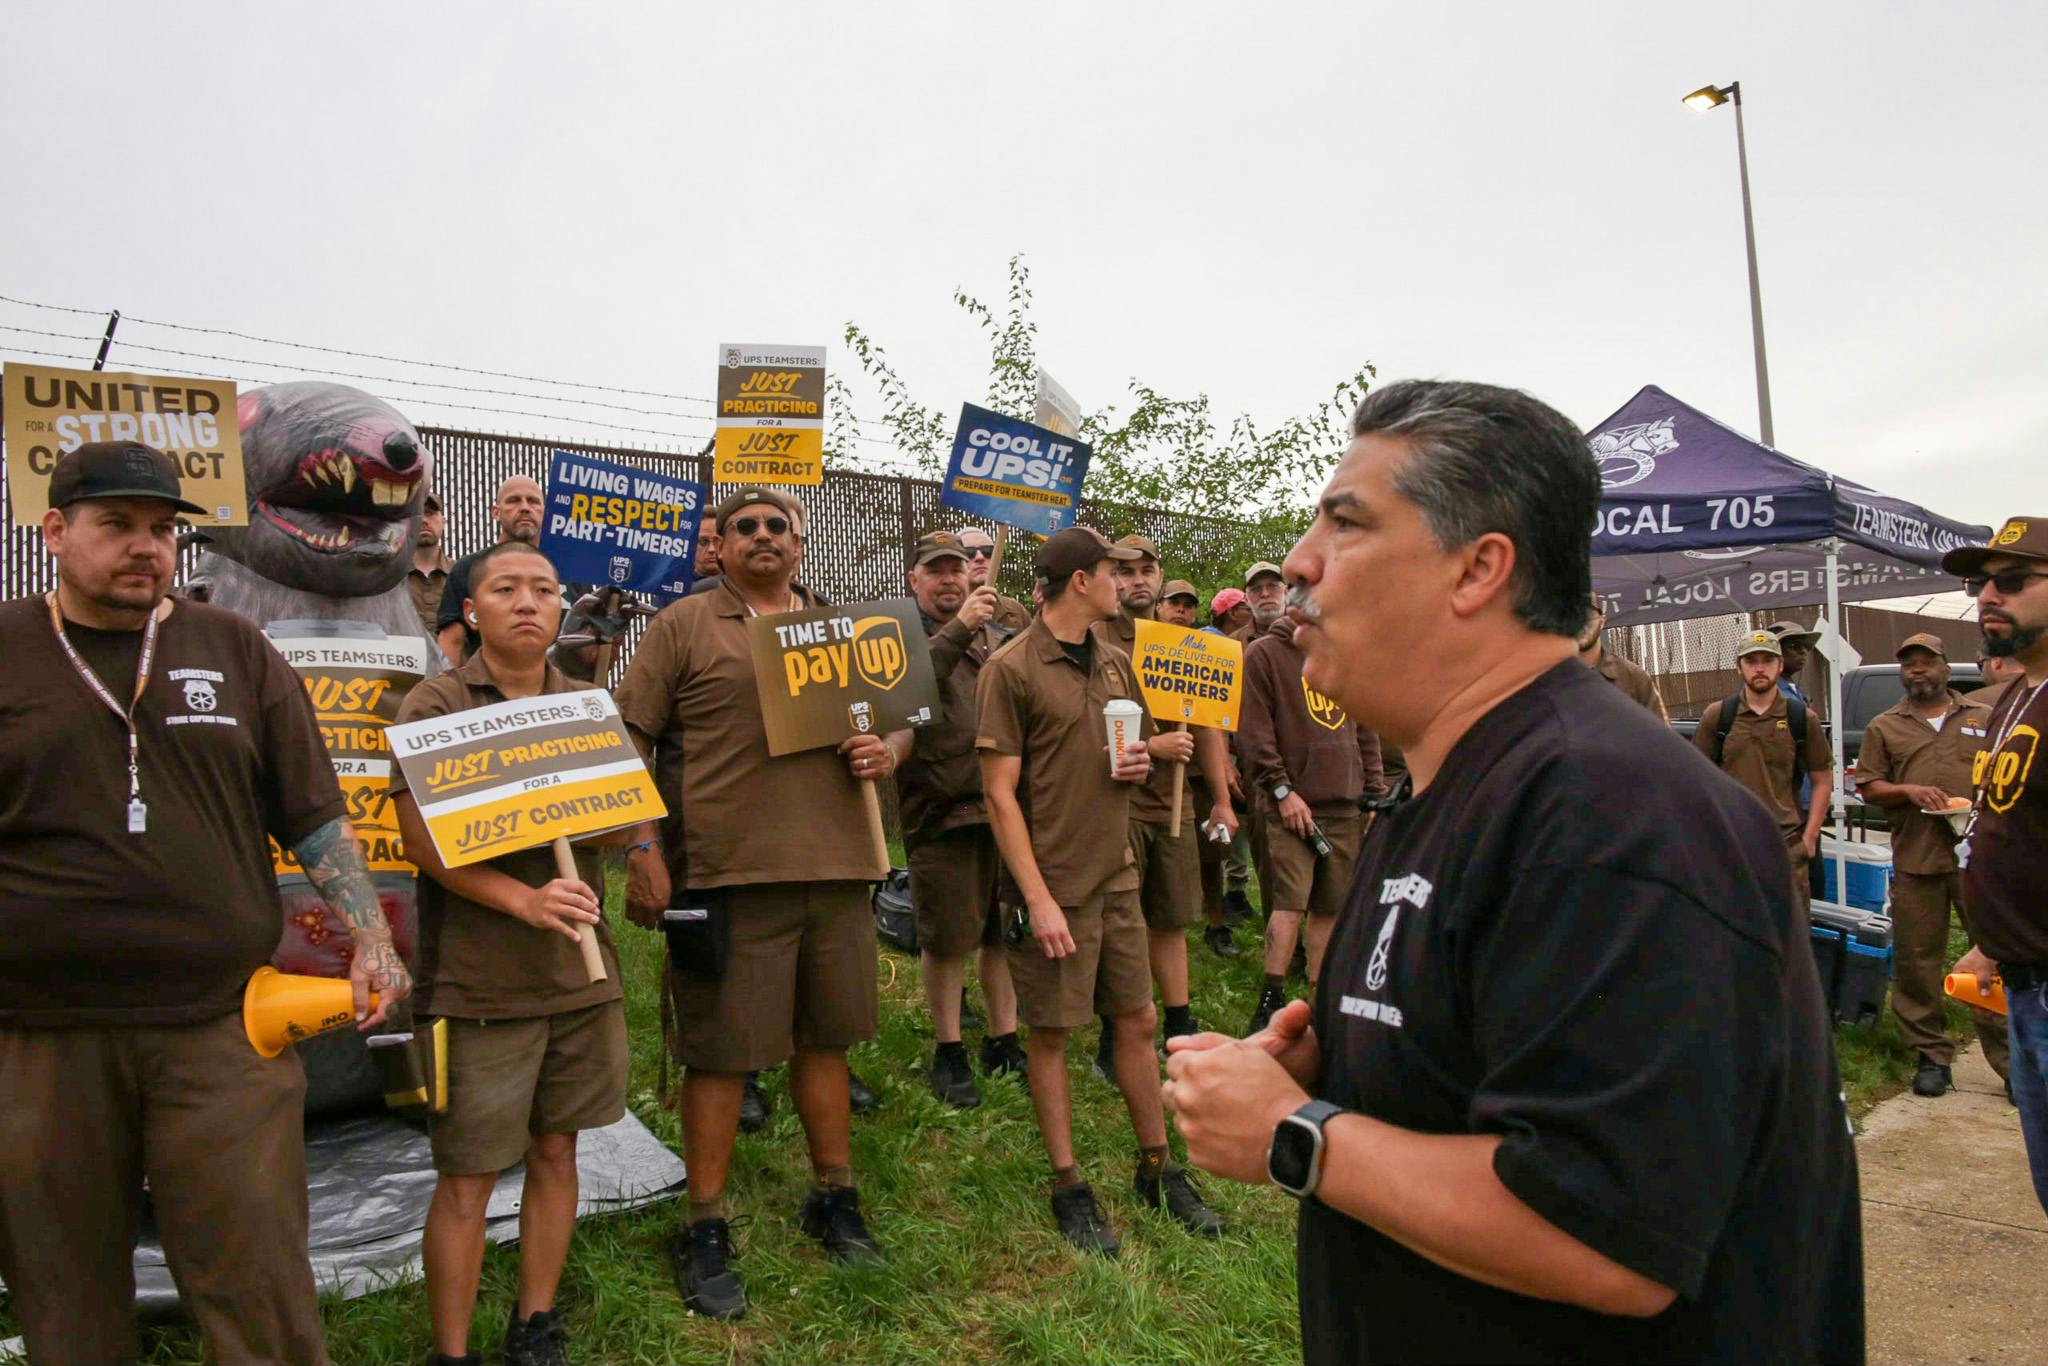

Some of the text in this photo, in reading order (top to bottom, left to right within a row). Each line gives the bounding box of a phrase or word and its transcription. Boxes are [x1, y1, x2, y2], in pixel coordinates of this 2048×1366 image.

[743, 355, 820, 366] UPS TEAMSTERS:
[24, 376, 220, 416] UNITED
[739, 371, 803, 392] JUST
[723, 399, 817, 414] PRACTICING
[25, 420, 53, 432] FOR A
[56, 412, 219, 454] STRONG
[738, 432, 800, 452] JUST
[968, 428, 1074, 466] COOL IT,
[722, 460, 814, 475] CONTRACT
[960, 447, 1063, 490] UPS!
[558, 462, 697, 510] LIVING WAGES
[958, 479, 1069, 506] PREPARE FOR TEAMSTER HEAT
[555, 493, 692, 532] AND RESPECT FOR
[1706, 495, 1775, 531] 705
[1852, 502, 1930, 550] TEAMSTERS
[550, 514, 690, 558] PART-TIMERS!
[775, 616, 855, 648] TIME TO
[1178, 633, 1208, 651] Make
[321, 650, 418, 669] TEAMSTERS:
[783, 636, 901, 697] pay up
[1141, 655, 1234, 686] AMERICAN
[1143, 643, 1235, 669] UPS DELIVER FOR
[1143, 673, 1229, 702] WORKERS
[406, 705, 580, 751] UPS TEAMSTERS:
[1114, 720, 1125, 761] DUNKI
[332, 762, 367, 773] OR A
[425, 730, 622, 787] JUST PRACTICING
[523, 775, 561, 791] FOR A
[455, 787, 645, 848] JUST CONTRACT
